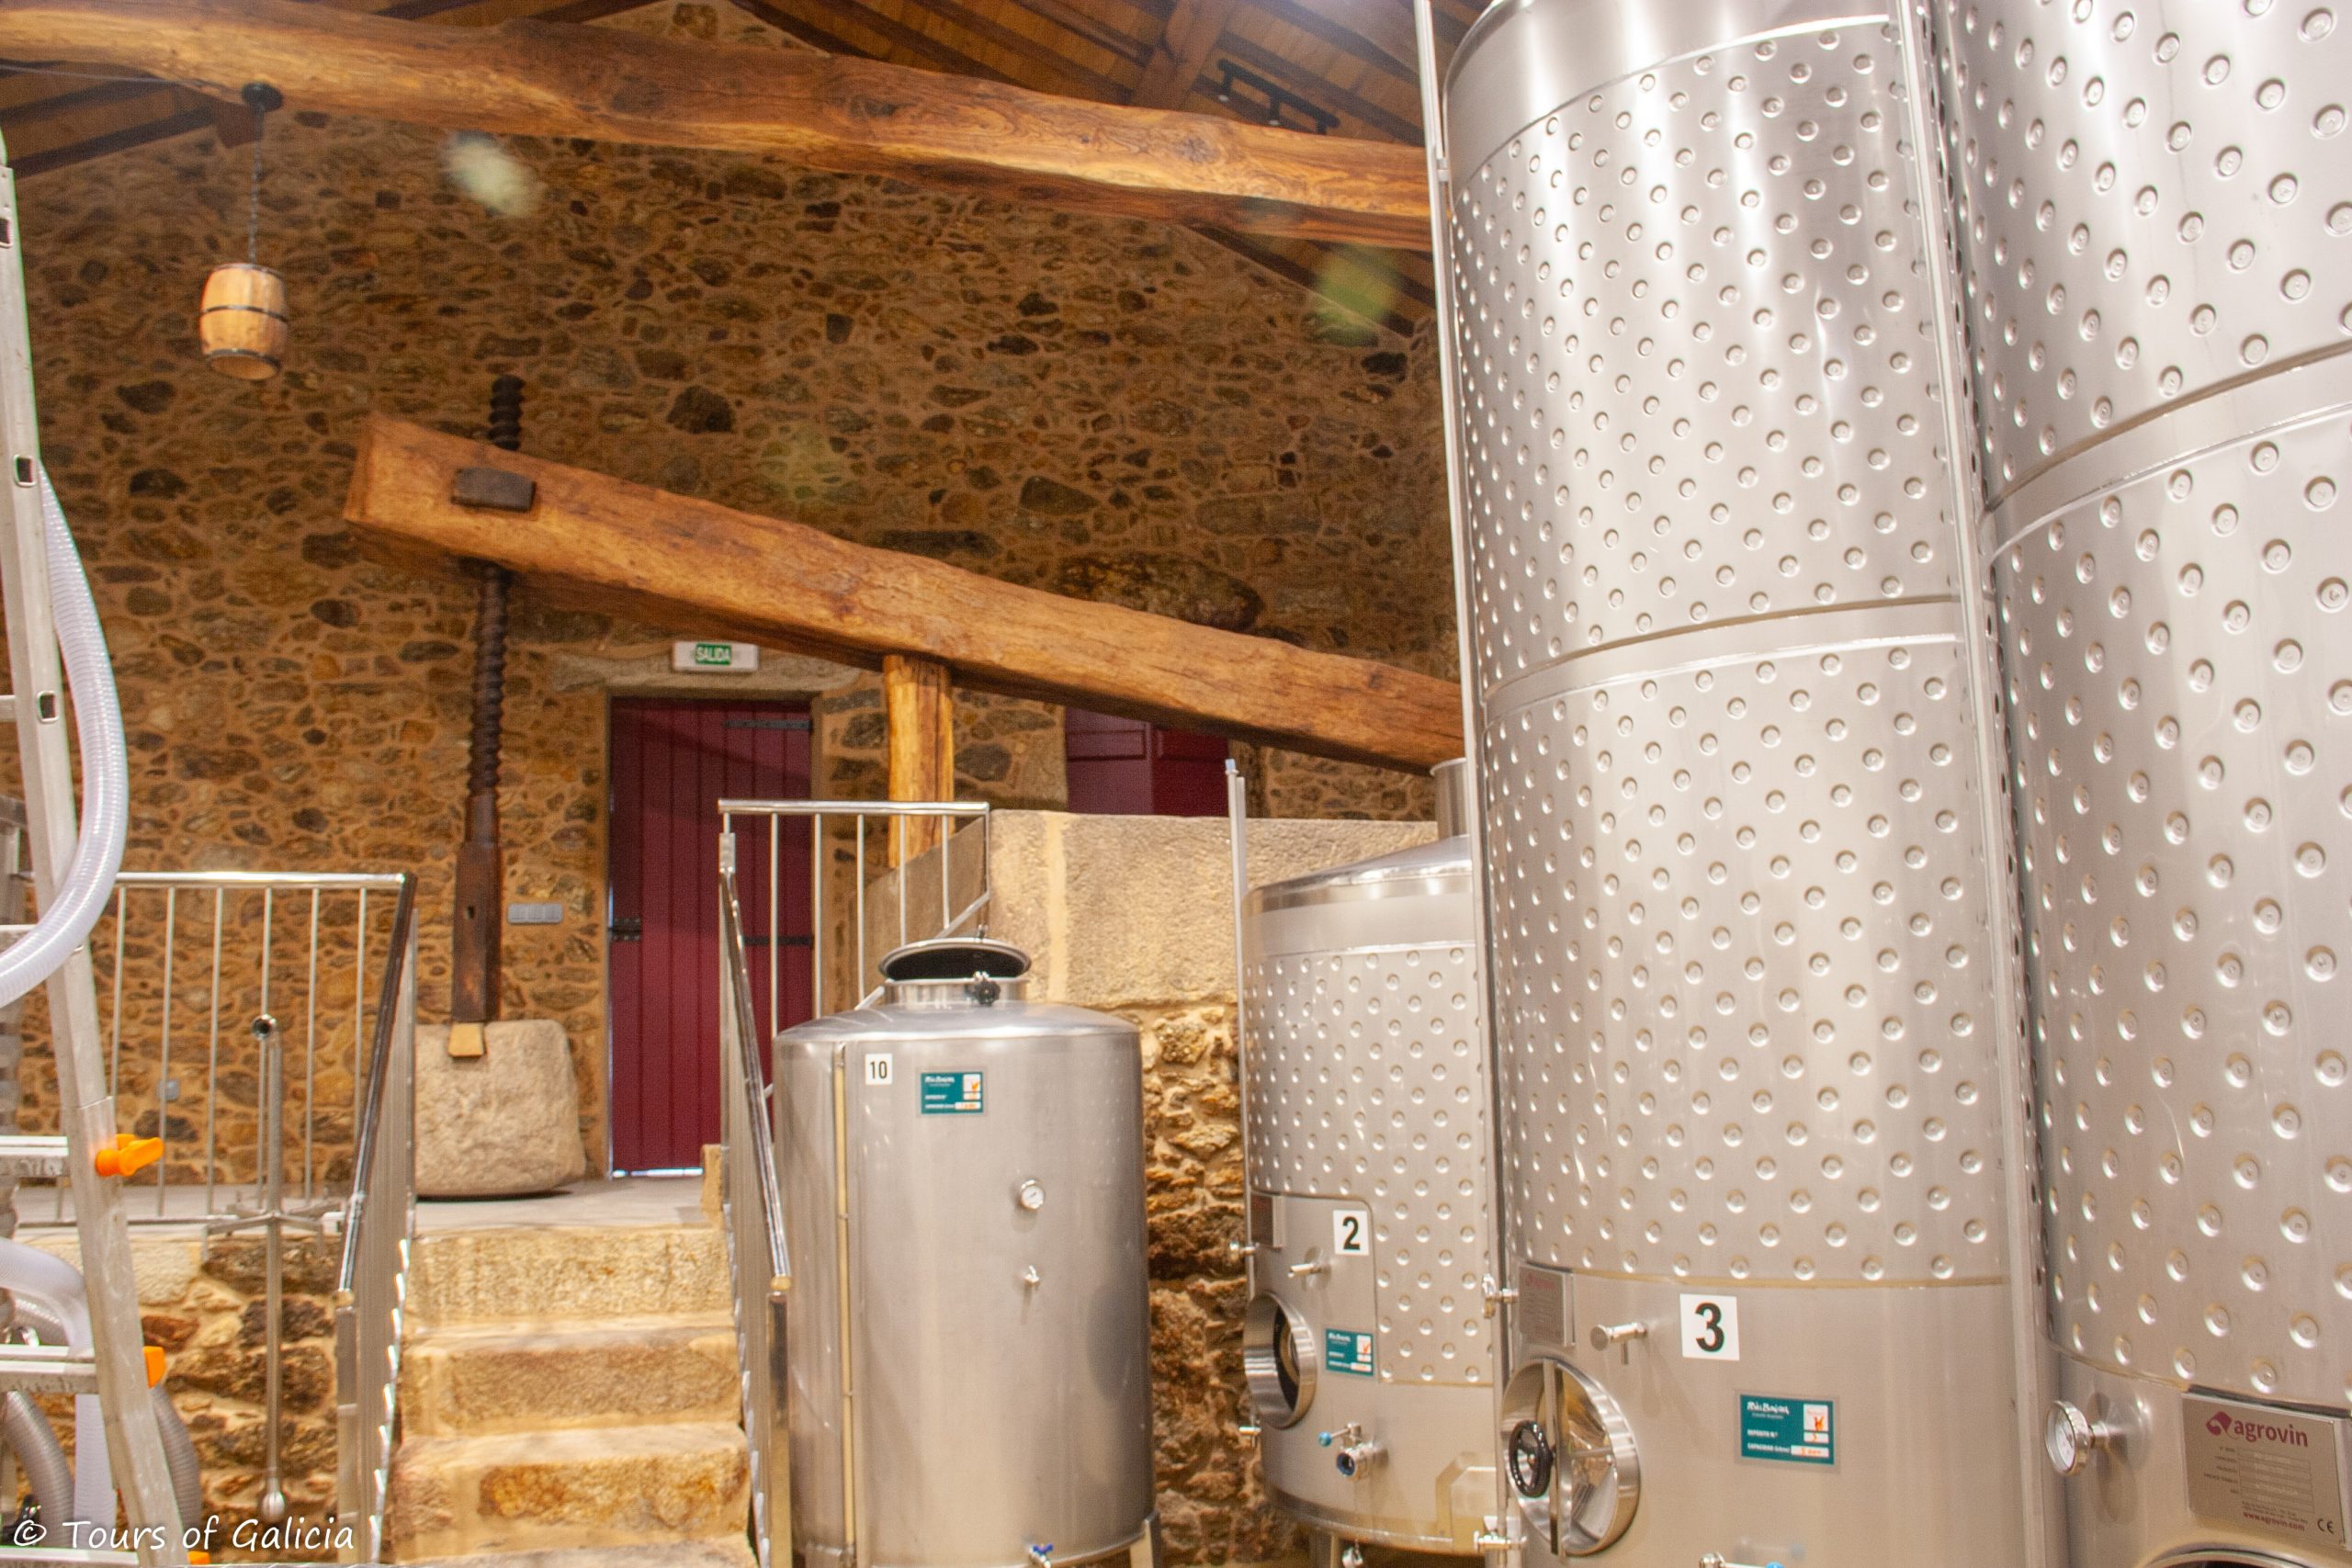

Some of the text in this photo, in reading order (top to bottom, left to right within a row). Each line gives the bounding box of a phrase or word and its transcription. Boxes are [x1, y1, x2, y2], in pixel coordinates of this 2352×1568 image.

[695, 646, 730, 662] SALIDA
[869, 1061, 888, 1079] 10
[1342, 1215, 1361, 1250] 2
[1694, 1302, 1725, 1352] 3
[2233, 1420, 2308, 1448] agrovin
[2243, 1511, 2305, 1531] www.agrovin.com
[2317, 1517, 2335, 1535] CE
